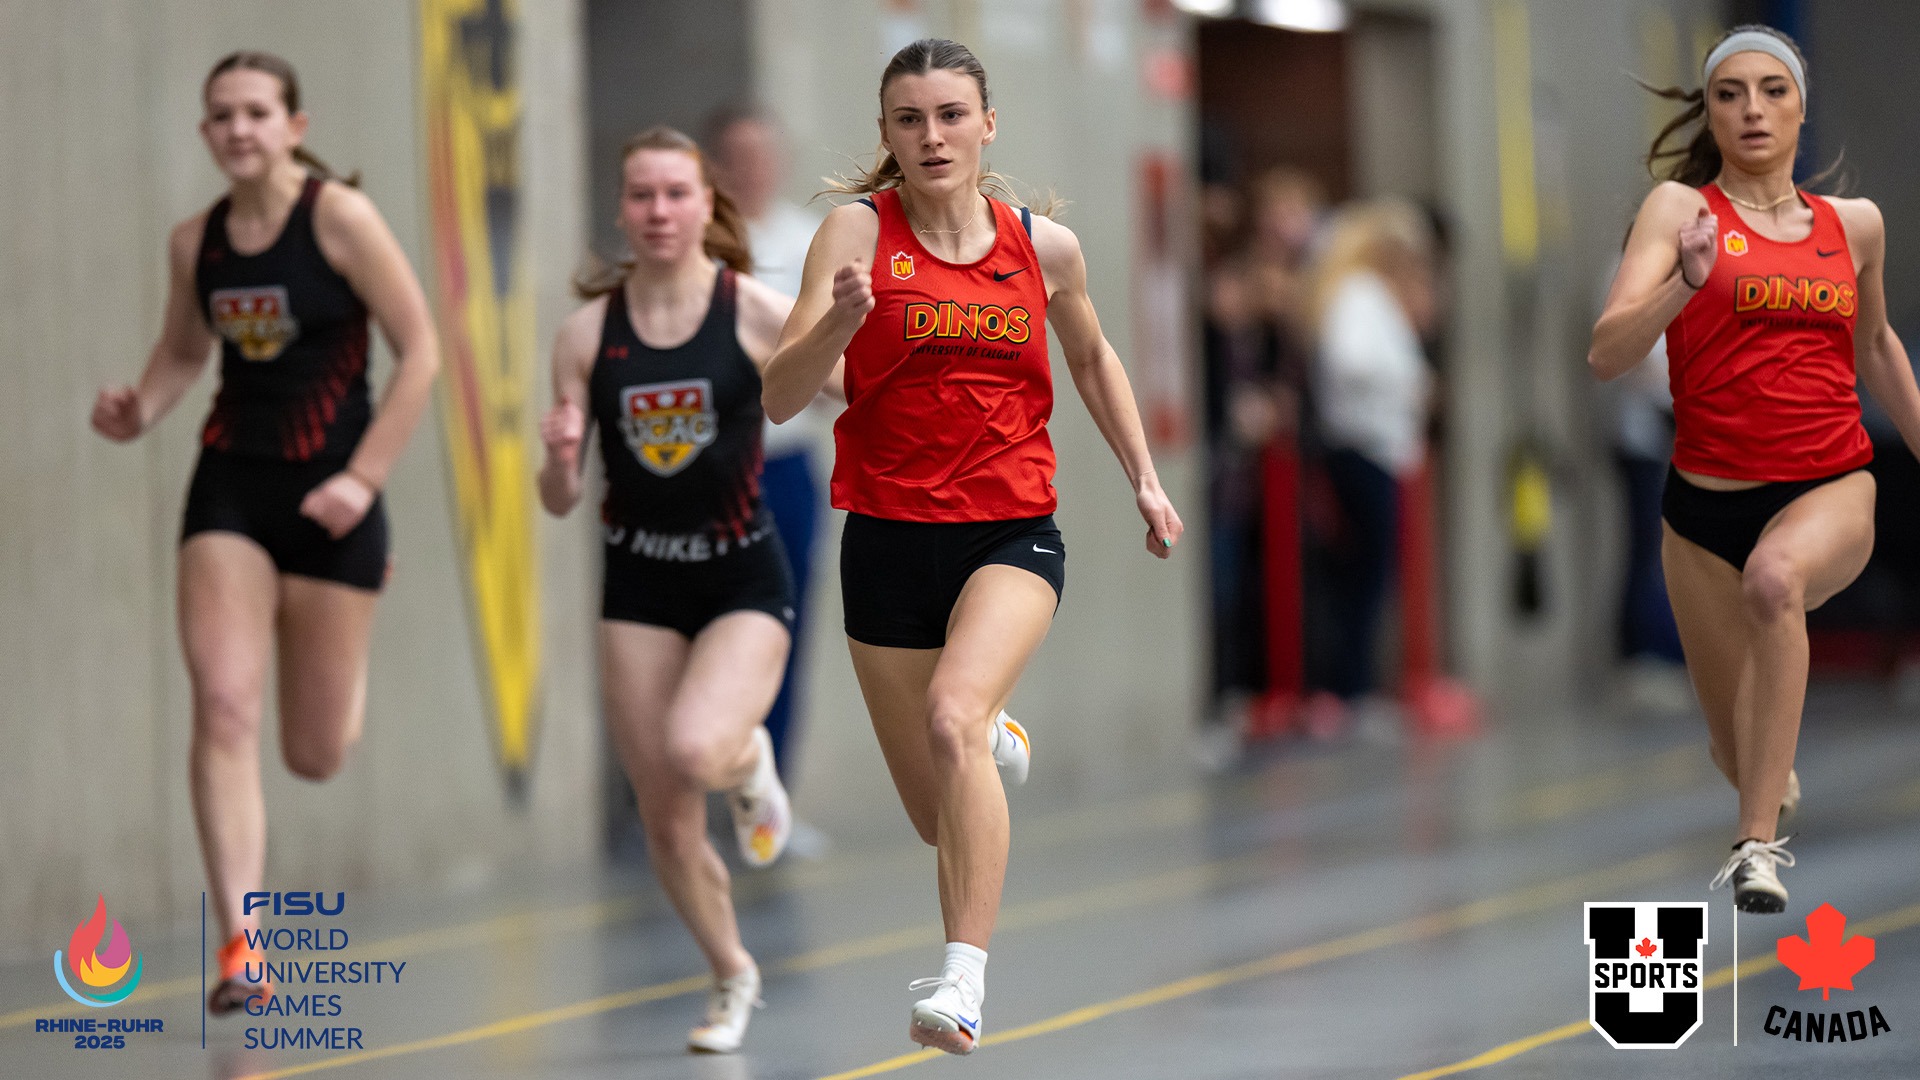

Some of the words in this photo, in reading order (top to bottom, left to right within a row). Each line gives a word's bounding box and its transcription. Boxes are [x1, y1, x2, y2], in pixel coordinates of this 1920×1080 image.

[893, 261, 912, 276] CW
[1734, 274, 1855, 318] DINOS
[904, 300, 1031, 344] DINOS
[909, 343, 965, 358] UNIVERSITY
[966, 345, 979, 358] OF
[980, 347, 1022, 361] CALGARY
